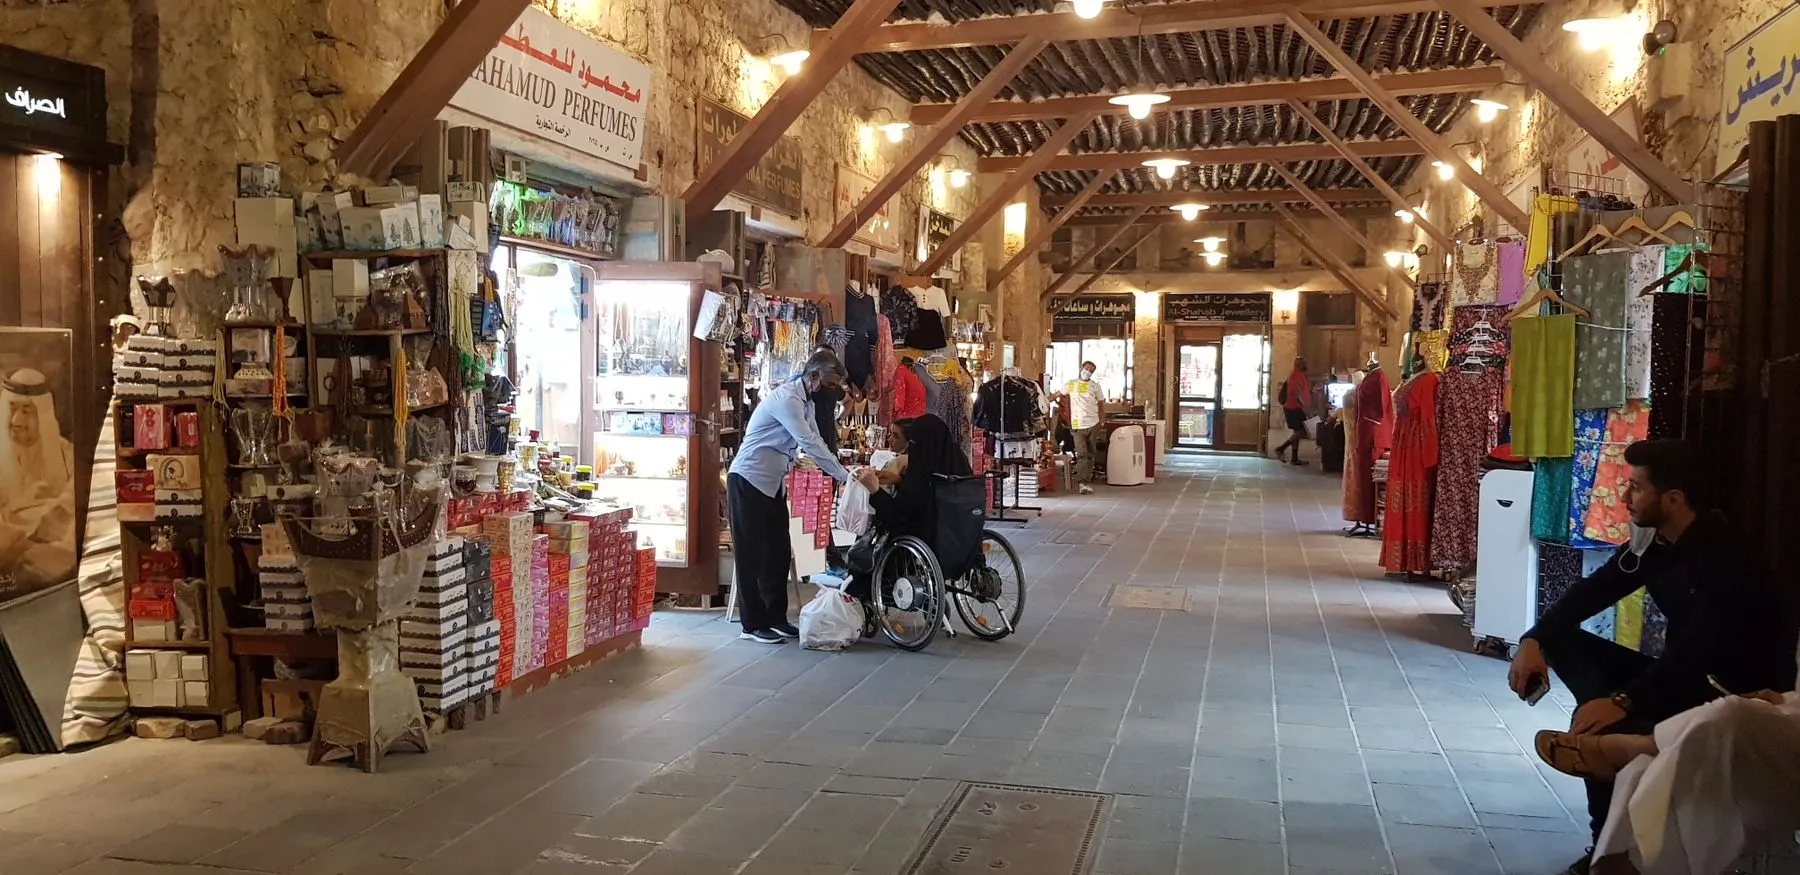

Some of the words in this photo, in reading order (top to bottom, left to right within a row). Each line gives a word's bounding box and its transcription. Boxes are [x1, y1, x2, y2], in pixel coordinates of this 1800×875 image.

[501, 22, 576, 73] للعط
[578, 59, 641, 103] محمود
[1726, 46, 1800, 125] ريش
[5, 86, 66, 118] الصراف
[471, 55, 557, 109] AHAMUD
[561, 87, 638, 142] PERFUMES
[762, 168, 801, 200] PERFUMES
[1063, 300, 1089, 312] ساعات
[1095, 300, 1131, 316] مجوهرات
[1168, 308, 1217, 316] Al-Shahab
[1220, 308, 1267, 317] Jewellery
[1169, 295, 1211, 307] الشهب
[1213, 295, 1266, 307] مجوهرات
